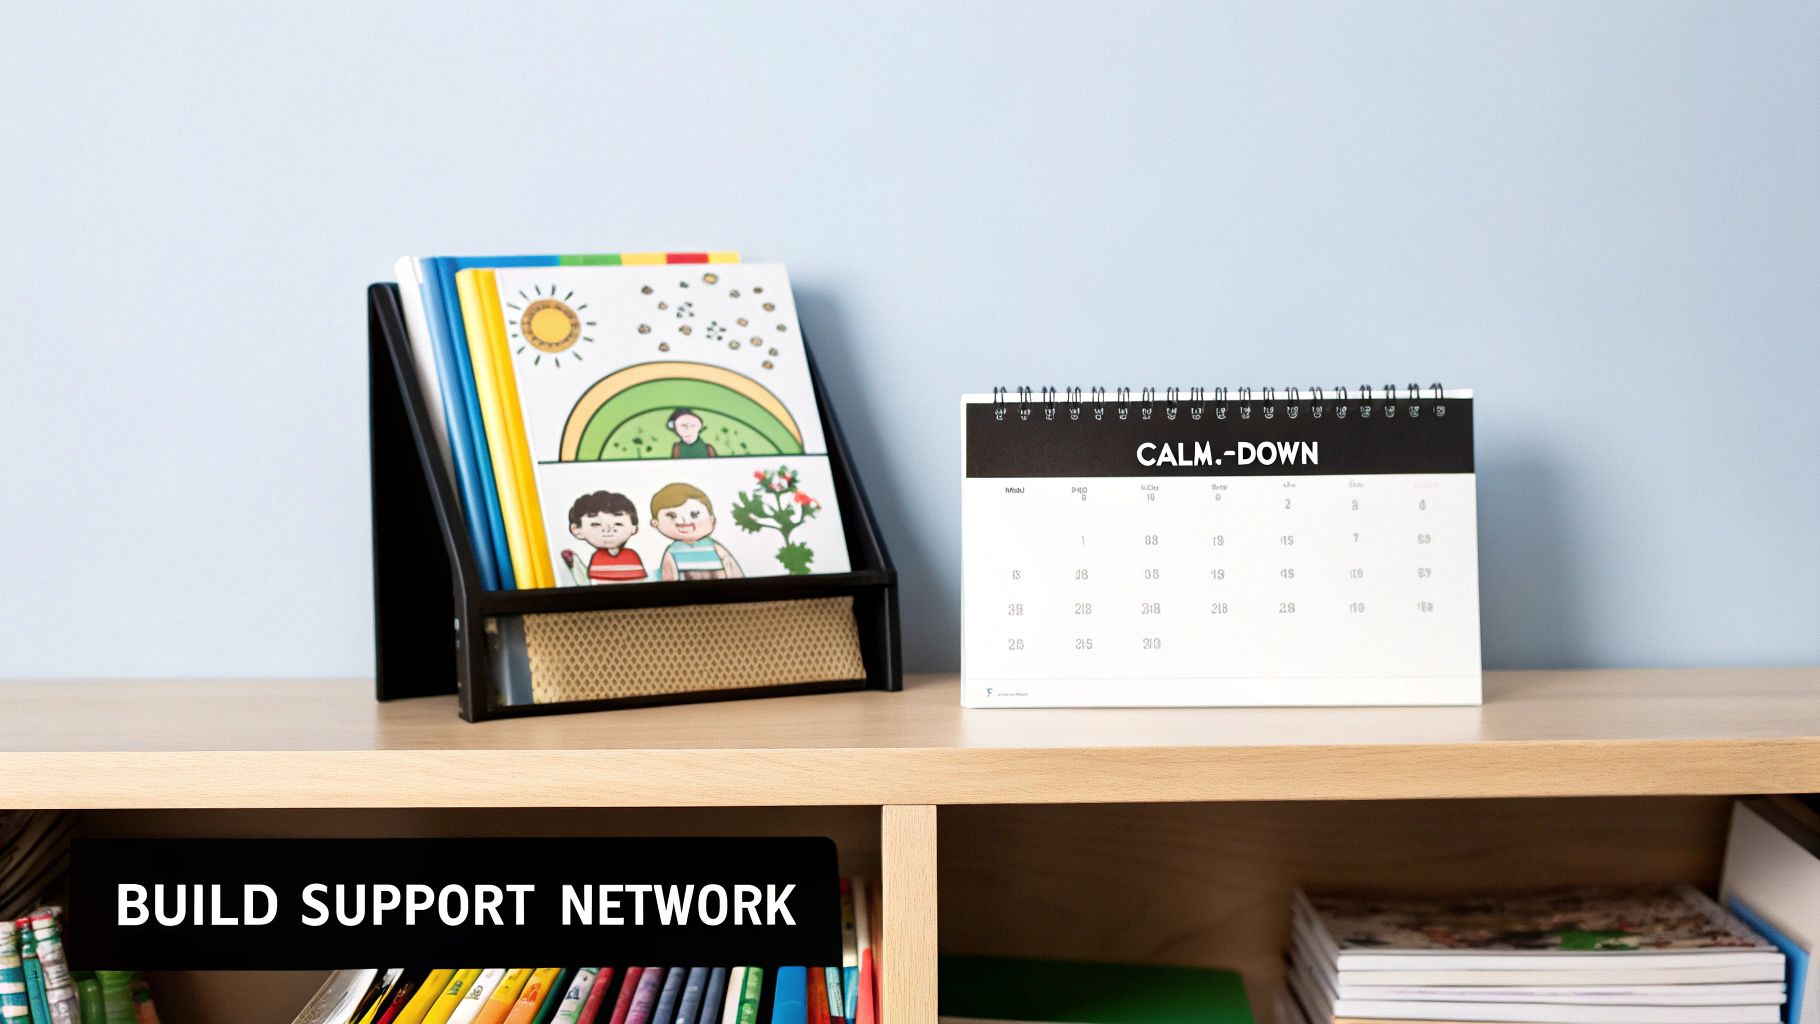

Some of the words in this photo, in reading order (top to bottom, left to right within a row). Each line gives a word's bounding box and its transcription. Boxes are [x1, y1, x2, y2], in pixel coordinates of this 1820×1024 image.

[117, 883, 278, 927] BUILD
[301, 882, 535, 927] SUPPORT
[562, 883, 797, 926] NETWORK
